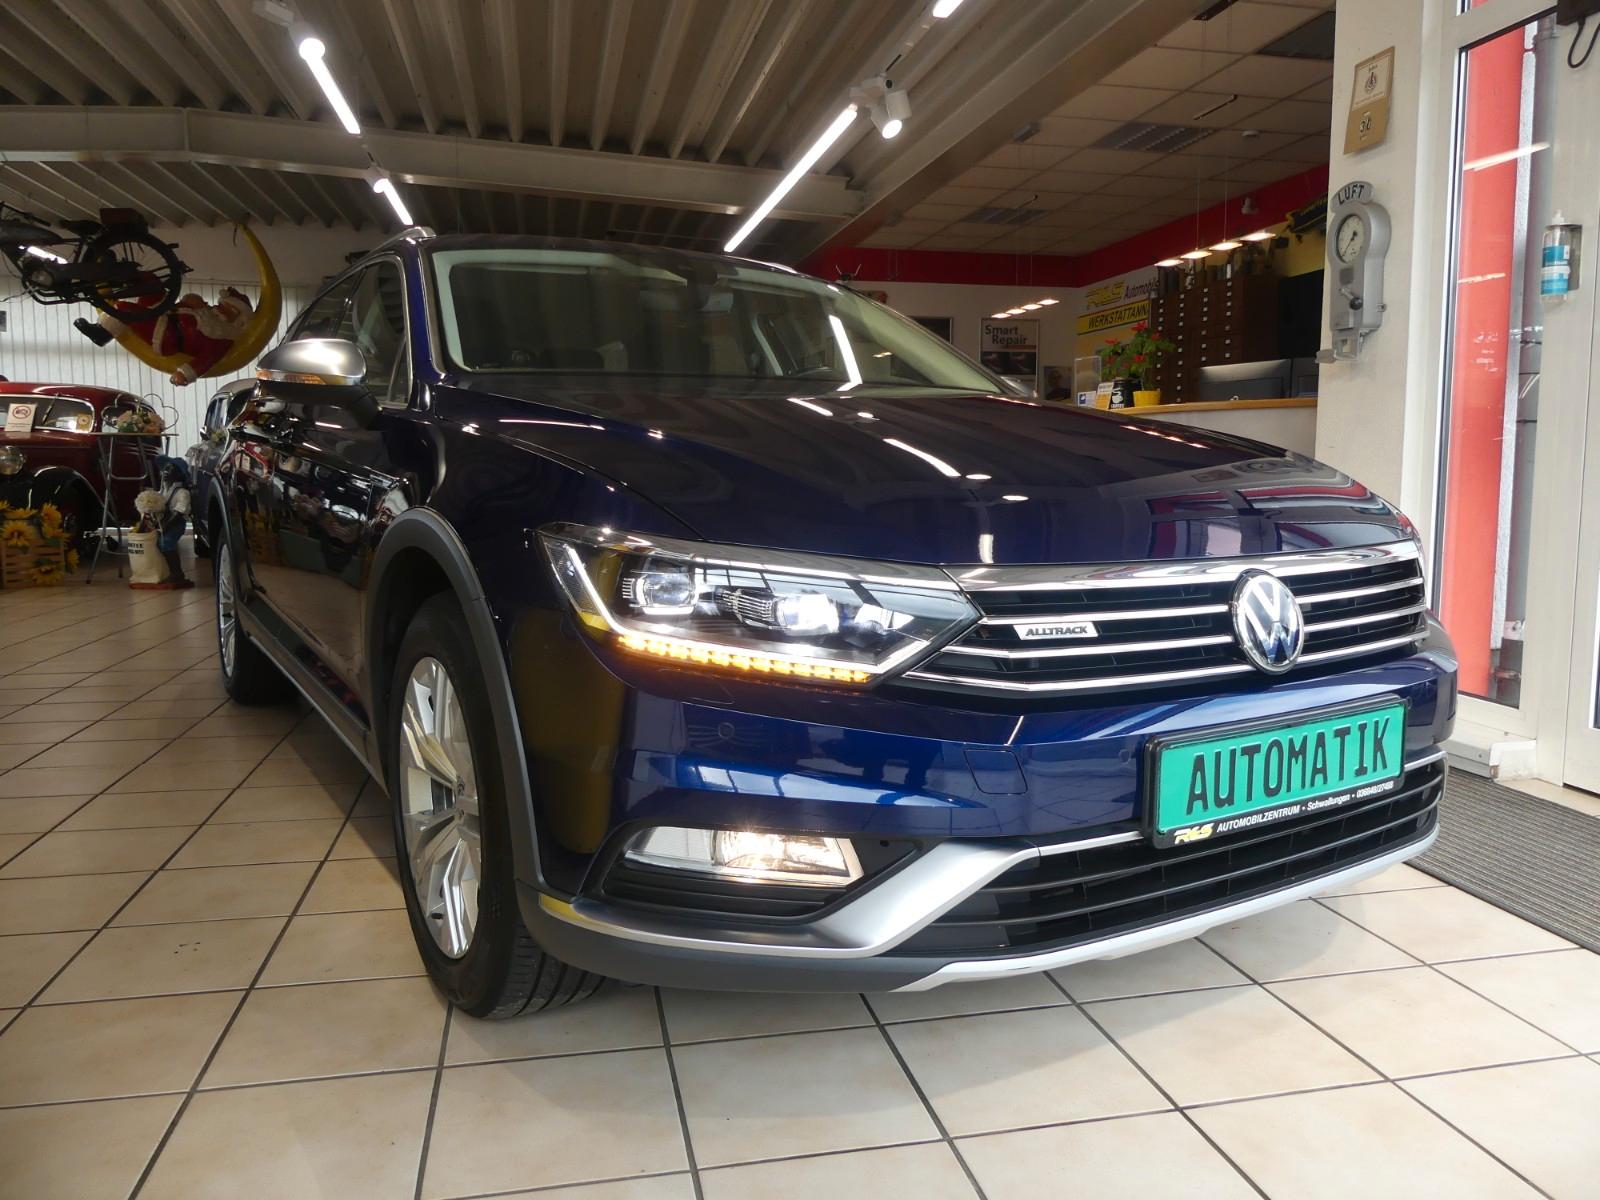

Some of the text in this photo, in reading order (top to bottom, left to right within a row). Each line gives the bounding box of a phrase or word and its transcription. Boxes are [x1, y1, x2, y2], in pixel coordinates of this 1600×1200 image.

[1337, 184, 1365, 205] LUFT
[984, 324, 1018, 336] Smart
[991, 334, 1028, 348] Repair
[1025, 625, 1088, 637] ALLTRACK
[1186, 716, 1391, 816] AUTOMATIK
[1216, 805, 1301, 833] AUTOMOBILZENTRUM
